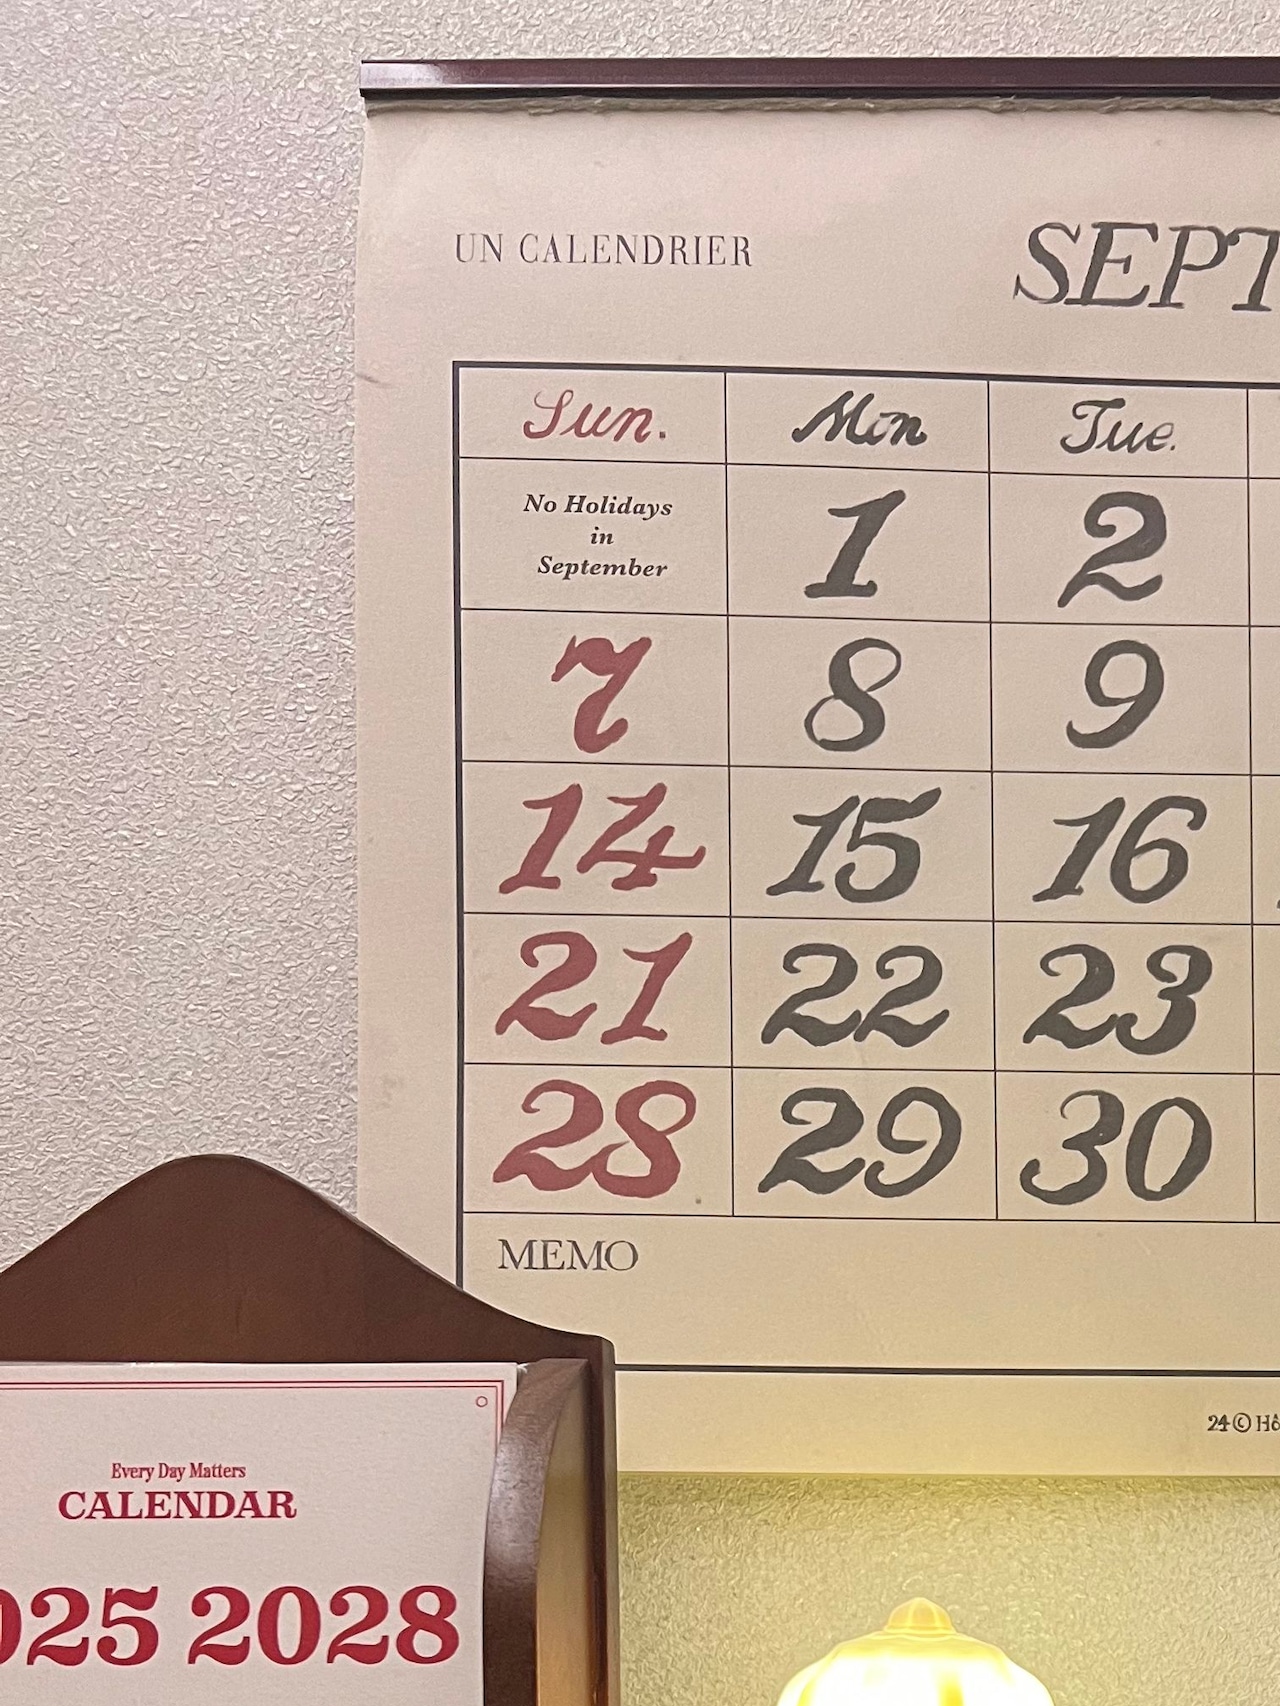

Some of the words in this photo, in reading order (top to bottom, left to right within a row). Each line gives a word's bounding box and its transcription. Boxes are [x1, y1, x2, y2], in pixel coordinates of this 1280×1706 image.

[457, 234, 501, 262] UN
[520, 234, 751, 266] CALENDRIER
[523, 390, 666, 443] Sun.
[1060, 398, 1175, 454] Tue.
[524, 494, 556, 512] No
[564, 495, 672, 521] Holidays
[591, 527, 612, 544] in
[804, 490, 906, 598] 1
[1058, 491, 1167, 608] 2
[538, 556, 667, 580] September
[551, 636, 652, 753] 7
[804, 638, 901, 752] 8
[1066, 640, 1164, 748] 9
[499, 783, 706, 894] 14
[766, 787, 941, 903] 15
[1033, 796, 1207, 903] 16
[495, 931, 692, 1045] 21
[761, 943, 949, 1047] 22
[1023, 944, 1212, 1055] 23
[493, 1080, 696, 1198] 28
[758, 1087, 962, 1198] 29
[1020, 1090, 1212, 1205] 30
[498, 1239, 638, 1271] MEMO
[112, 1463, 154, 1482] Every
[159, 1463, 185, 1482] Day
[190, 1463, 245, 1478] Matters
[59, 1491, 296, 1519] CALENDAR
[188, 1585, 459, 1665] 2028
